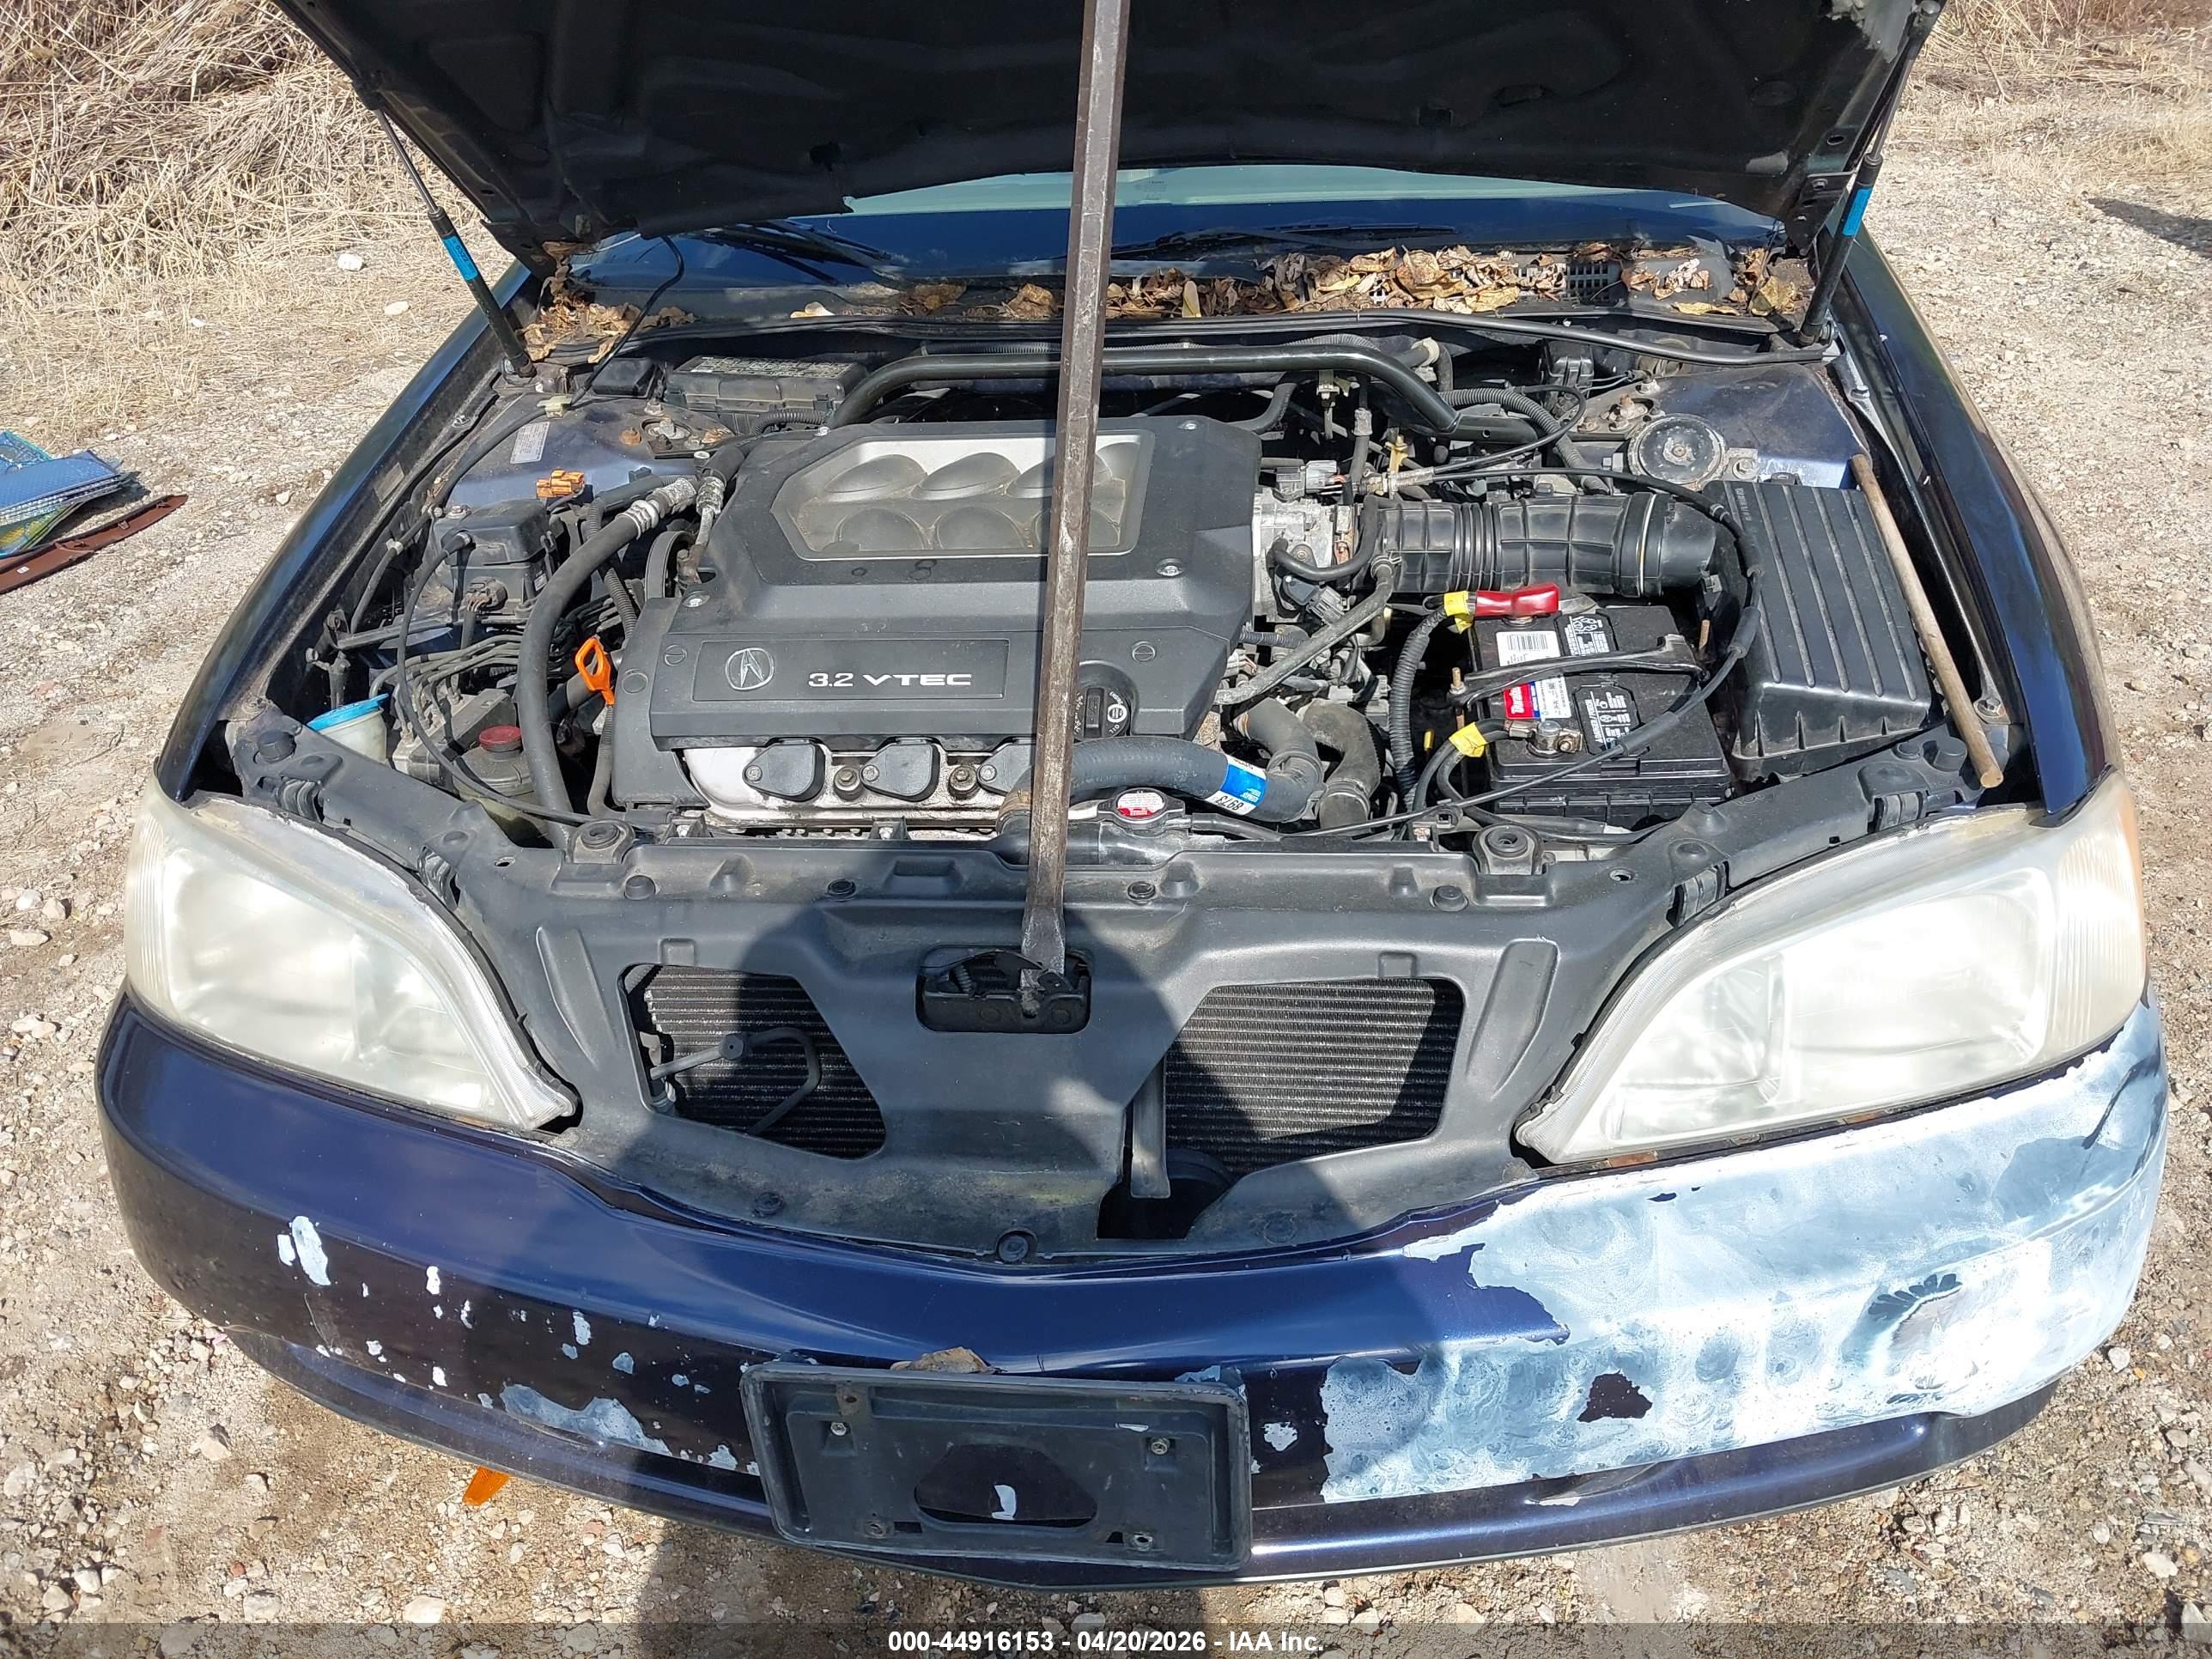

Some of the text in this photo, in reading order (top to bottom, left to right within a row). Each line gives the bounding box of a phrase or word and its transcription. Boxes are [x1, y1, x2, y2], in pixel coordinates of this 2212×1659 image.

[808, 672, 972, 687] 3.2 VTEC
[1216, 794, 1243, 811] 8973
